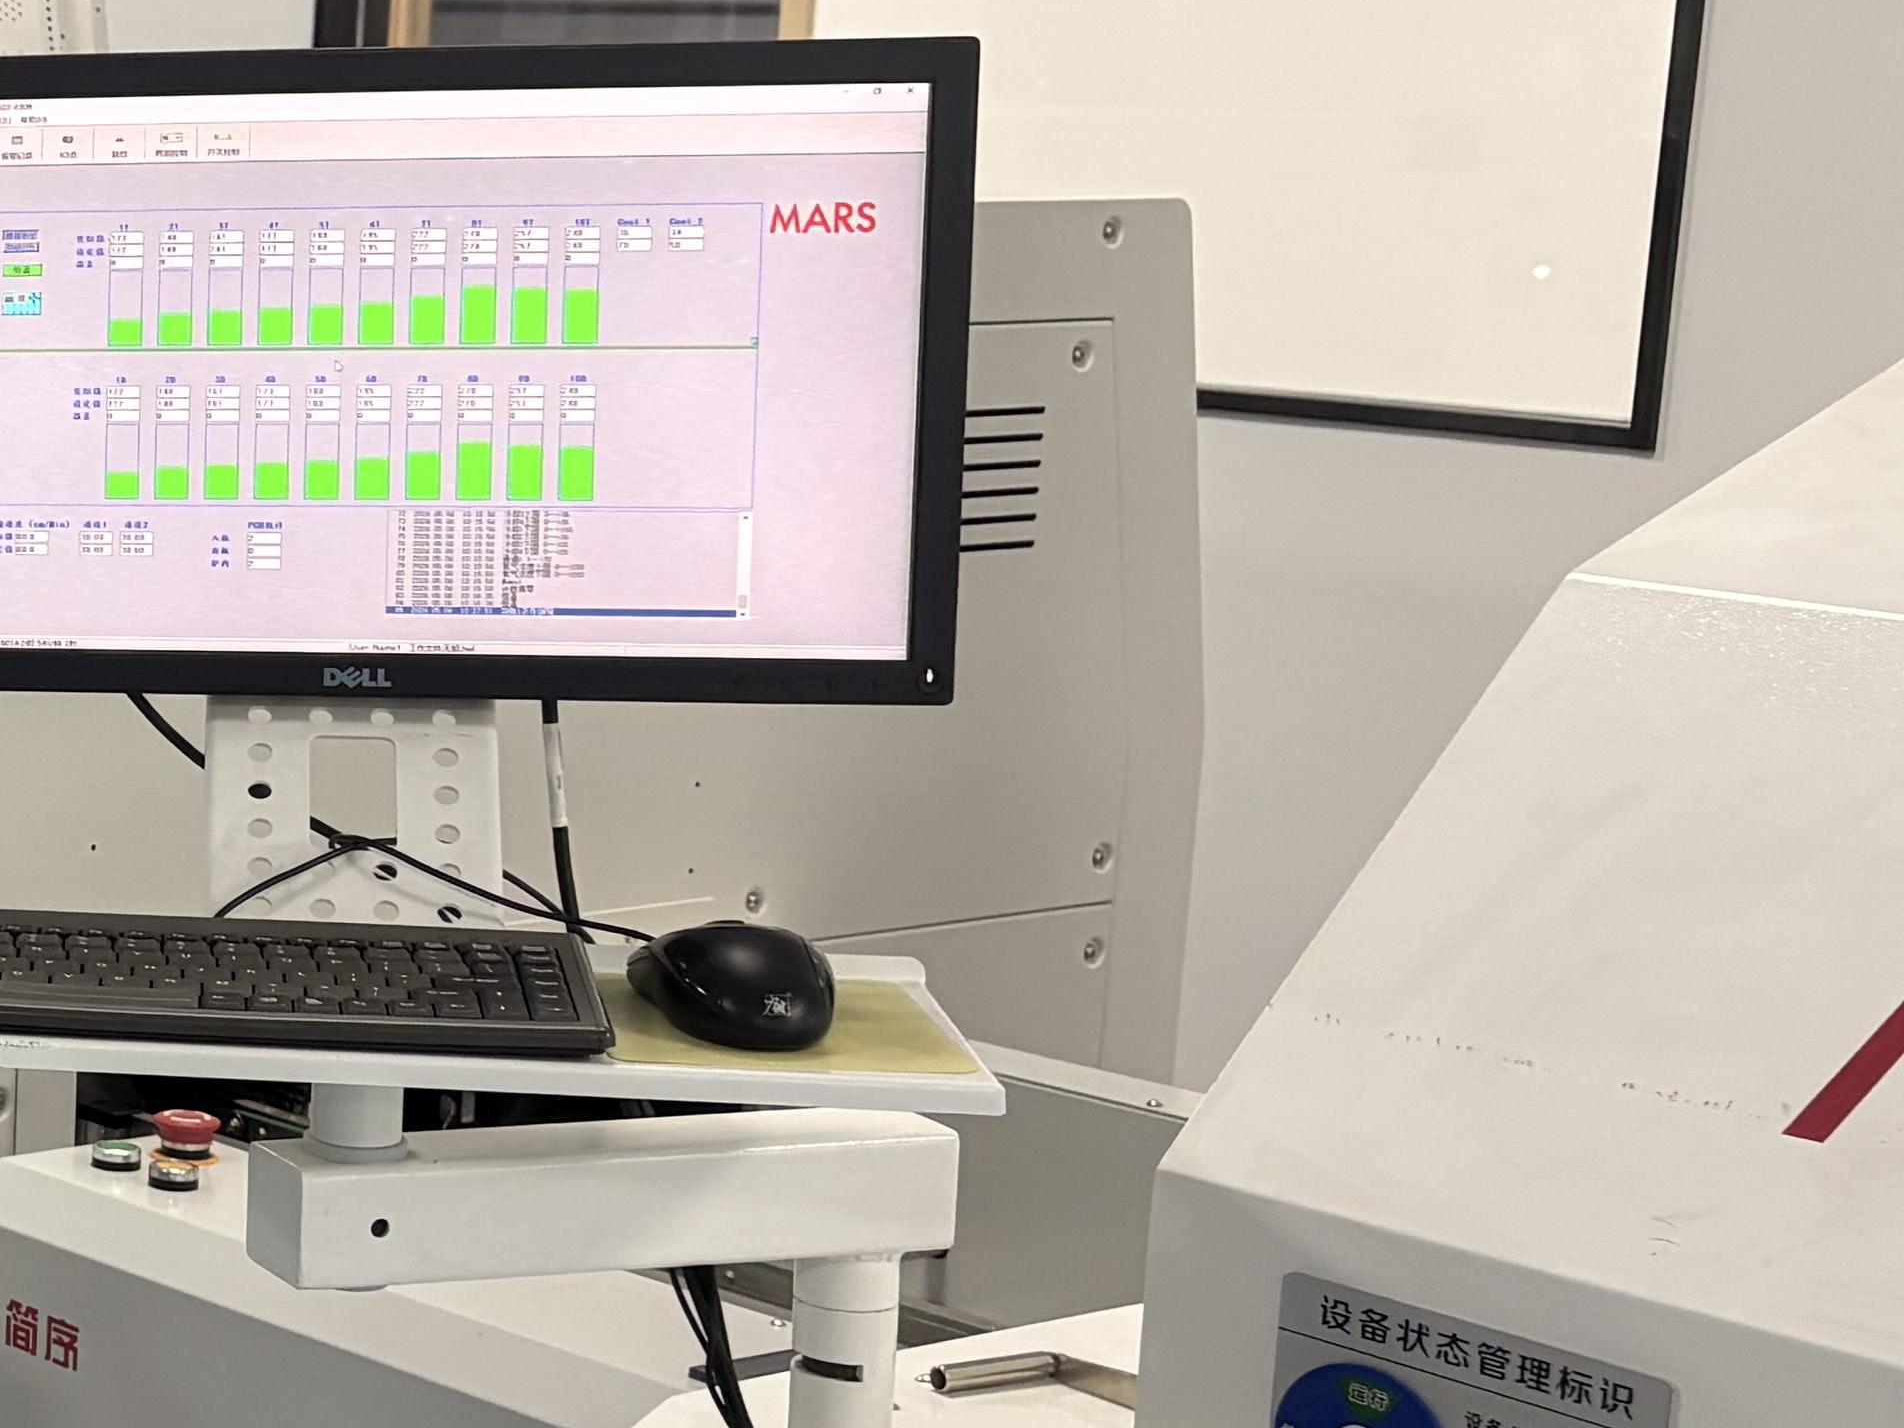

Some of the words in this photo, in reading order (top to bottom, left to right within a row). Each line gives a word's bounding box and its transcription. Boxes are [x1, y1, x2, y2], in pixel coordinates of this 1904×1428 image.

[769, 202, 877, 234] MARS
[323, 666, 392, 689] DELL
[4, 1298, 80, 1372] 简序
[1320, 1294, 1634, 1421] 设备状态管理标识
[1347, 1381, 1390, 1412] 运行
